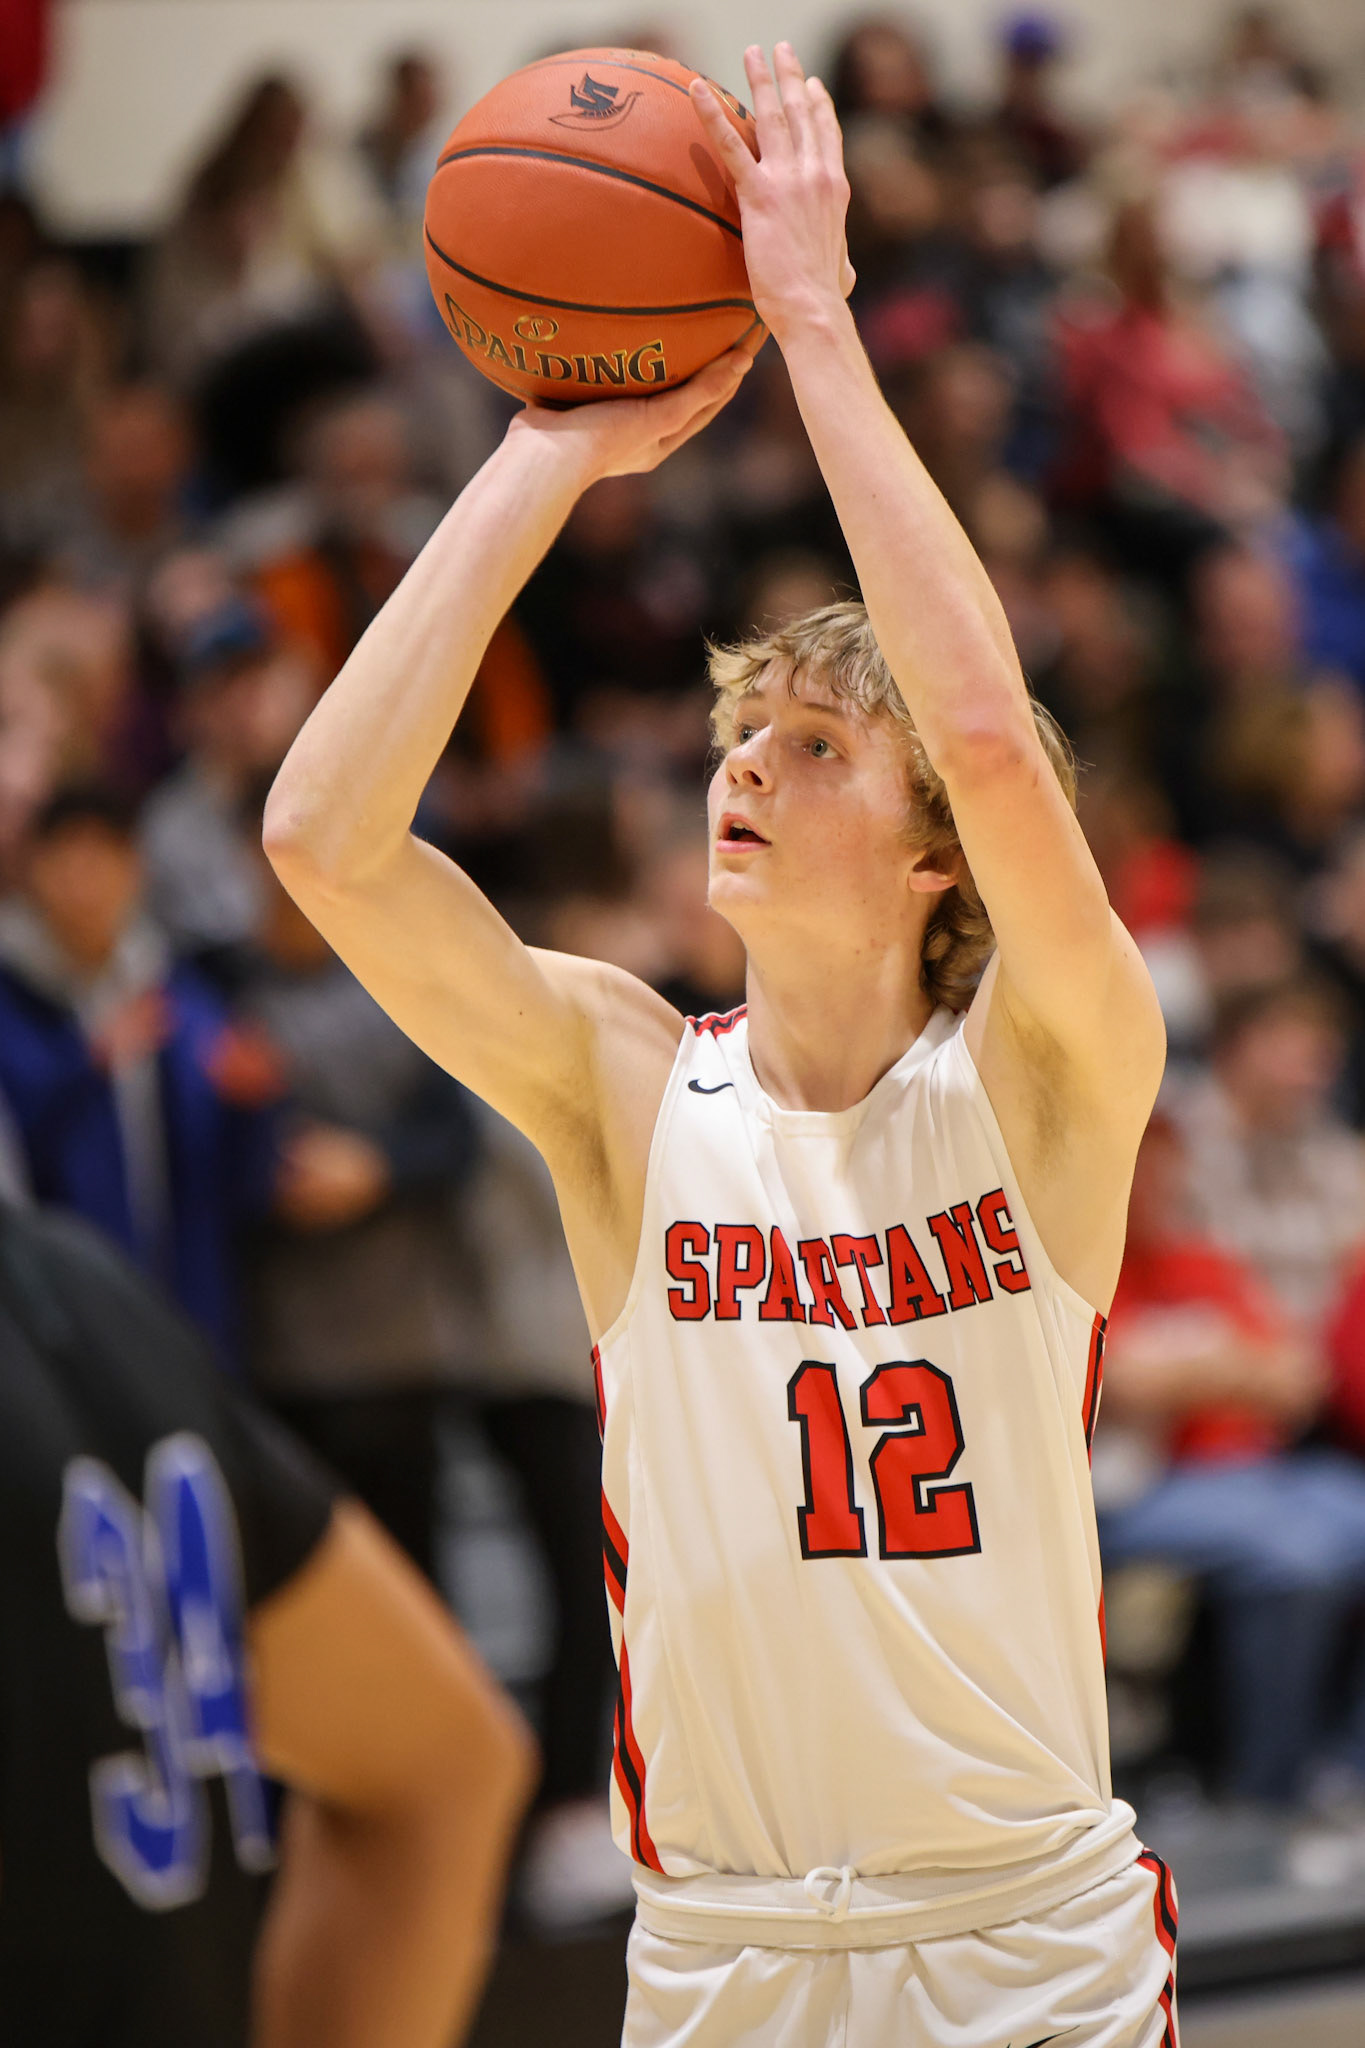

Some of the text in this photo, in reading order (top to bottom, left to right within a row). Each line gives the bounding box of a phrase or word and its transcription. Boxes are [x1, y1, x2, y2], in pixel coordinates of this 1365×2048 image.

[445, 292, 666, 386] SPALDING
[665, 1187, 1031, 1331] SPARTANS
[787, 1359, 982, 1560] 12
